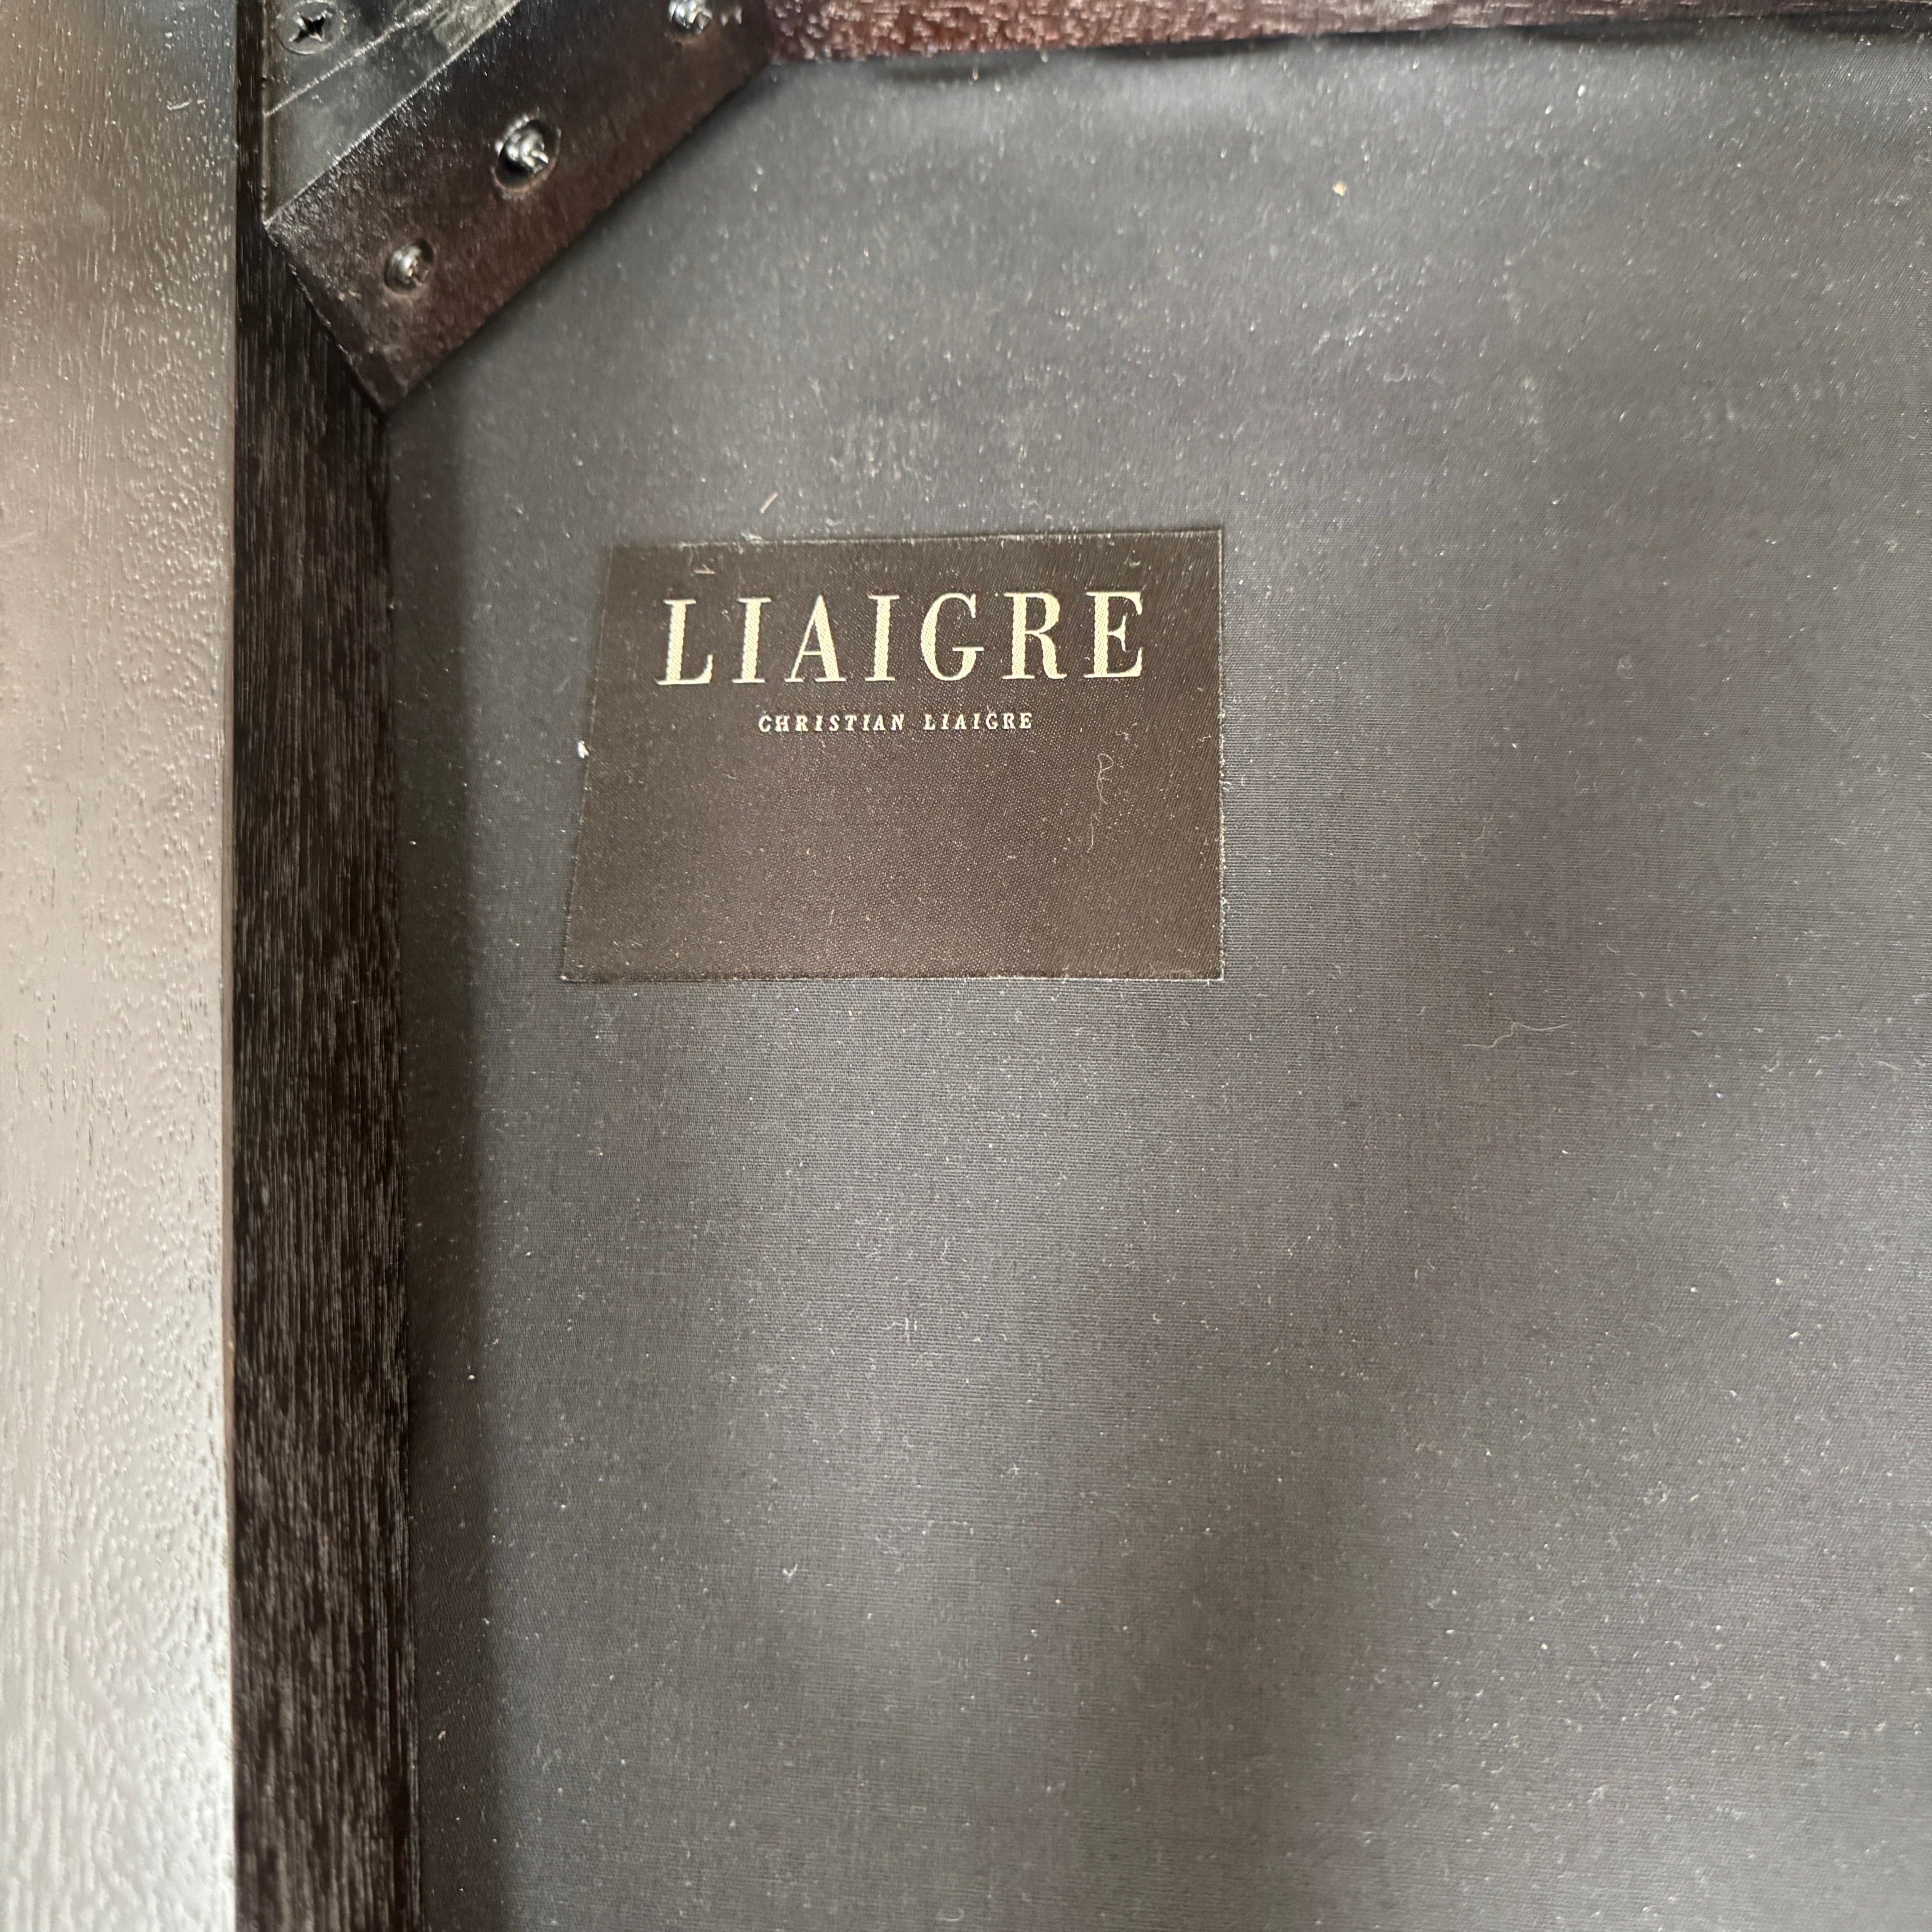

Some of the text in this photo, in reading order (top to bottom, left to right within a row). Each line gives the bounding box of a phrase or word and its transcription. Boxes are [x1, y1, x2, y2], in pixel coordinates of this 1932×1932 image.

[655, 591, 1144, 685] LIAIGRE
[758, 710, 1033, 732] CHRISTIAN LIAIGRE
